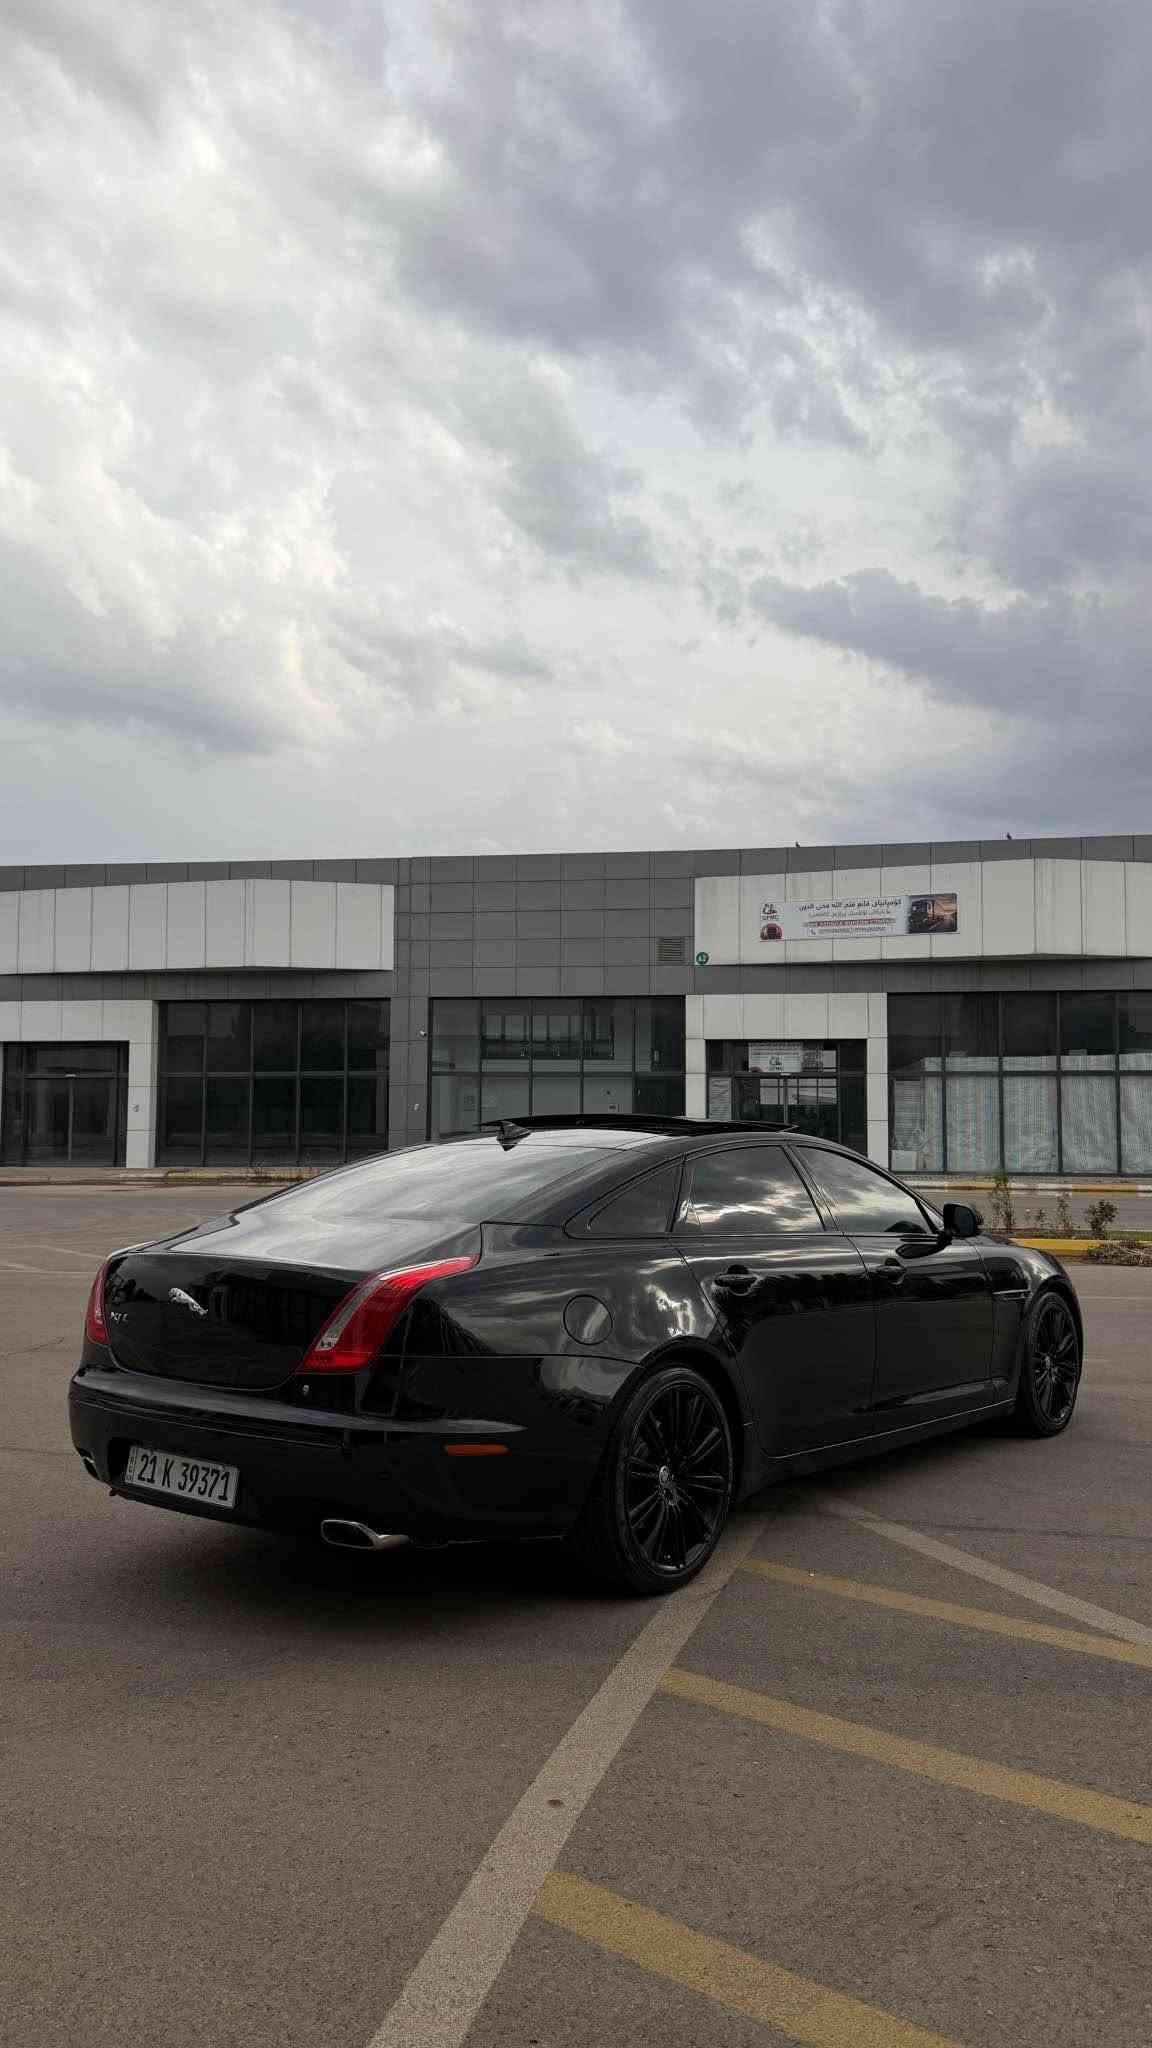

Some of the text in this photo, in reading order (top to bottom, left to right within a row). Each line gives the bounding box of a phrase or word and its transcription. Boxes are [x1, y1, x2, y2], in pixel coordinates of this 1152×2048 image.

[138, 1454, 157, 1484] 21
[162, 1458, 175, 1488] K
[178, 1462, 230, 1501] 39371
